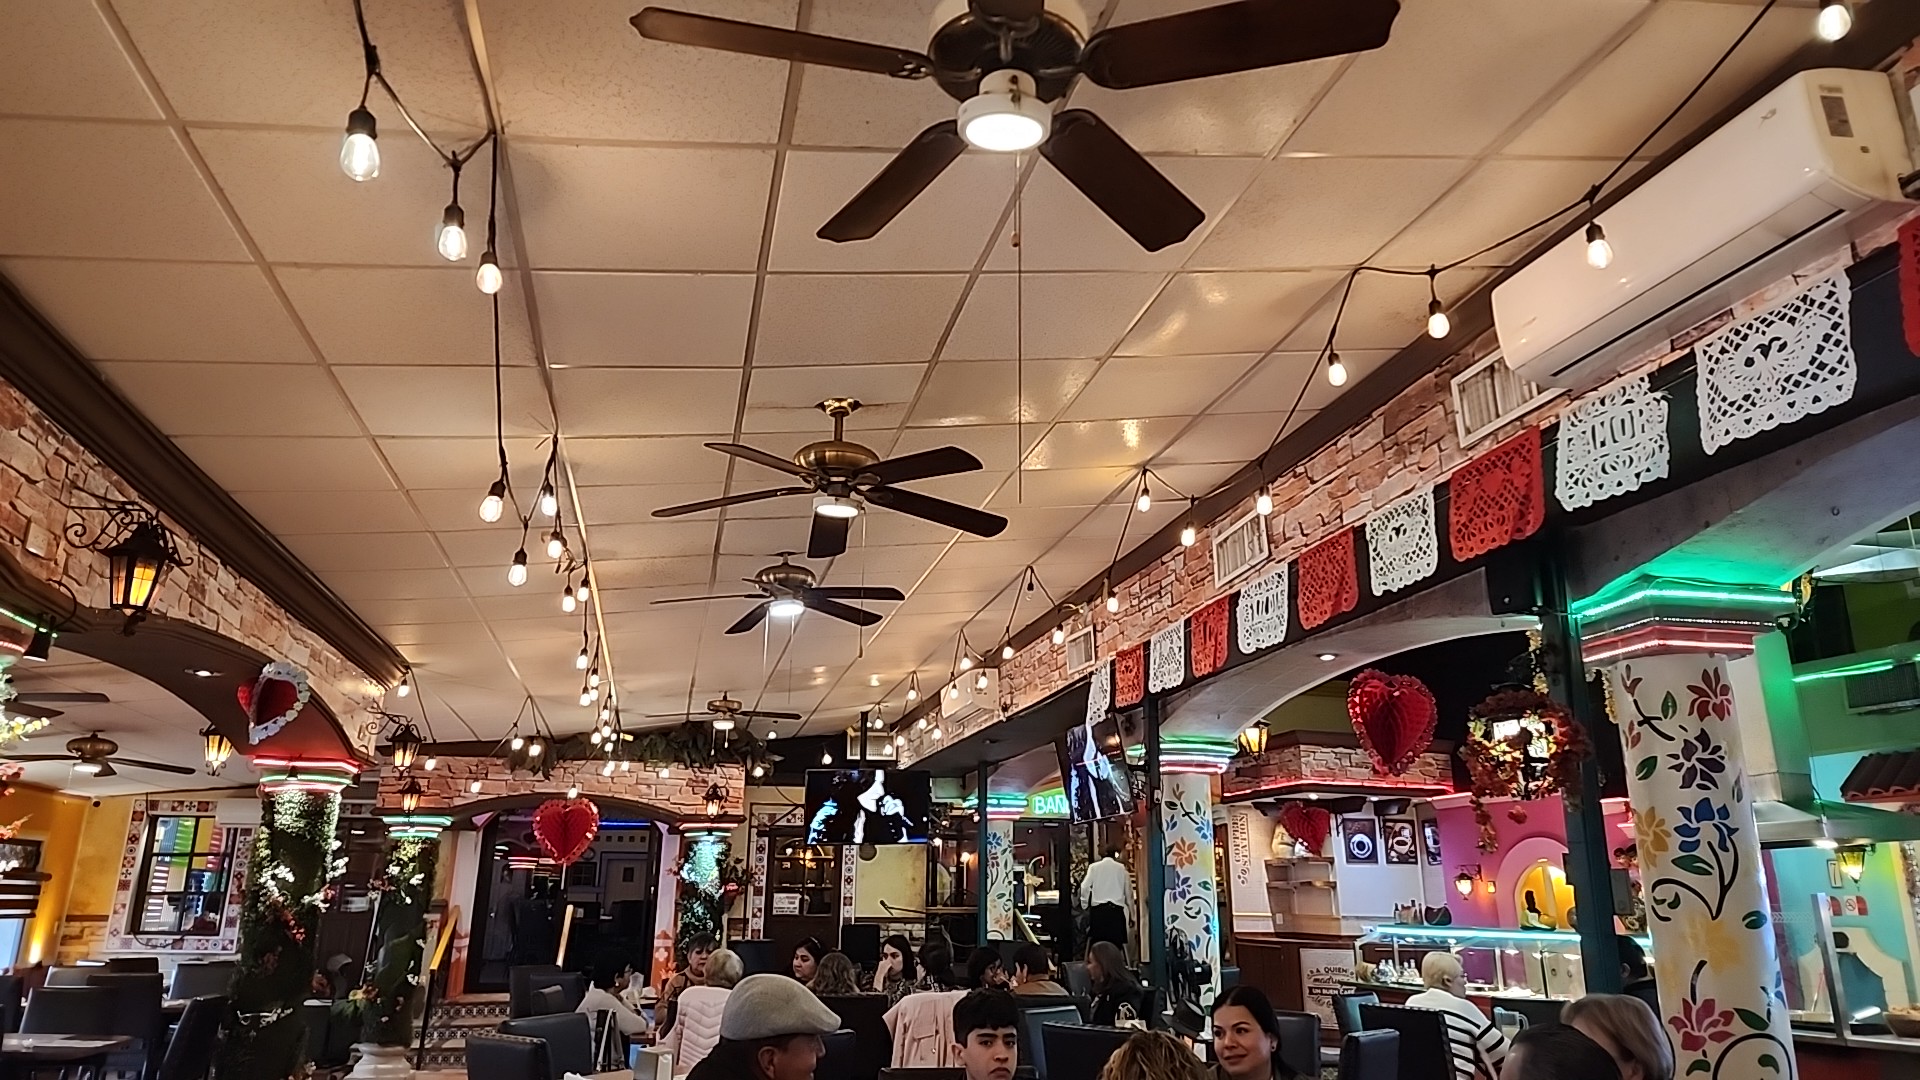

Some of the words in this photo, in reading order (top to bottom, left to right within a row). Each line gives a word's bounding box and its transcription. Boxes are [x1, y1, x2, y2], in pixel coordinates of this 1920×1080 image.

[1231, 814, 1241, 863] COFFEE
[1239, 815, 1249, 867] STATION
[1323, 966, 1348, 974] QUIEN
